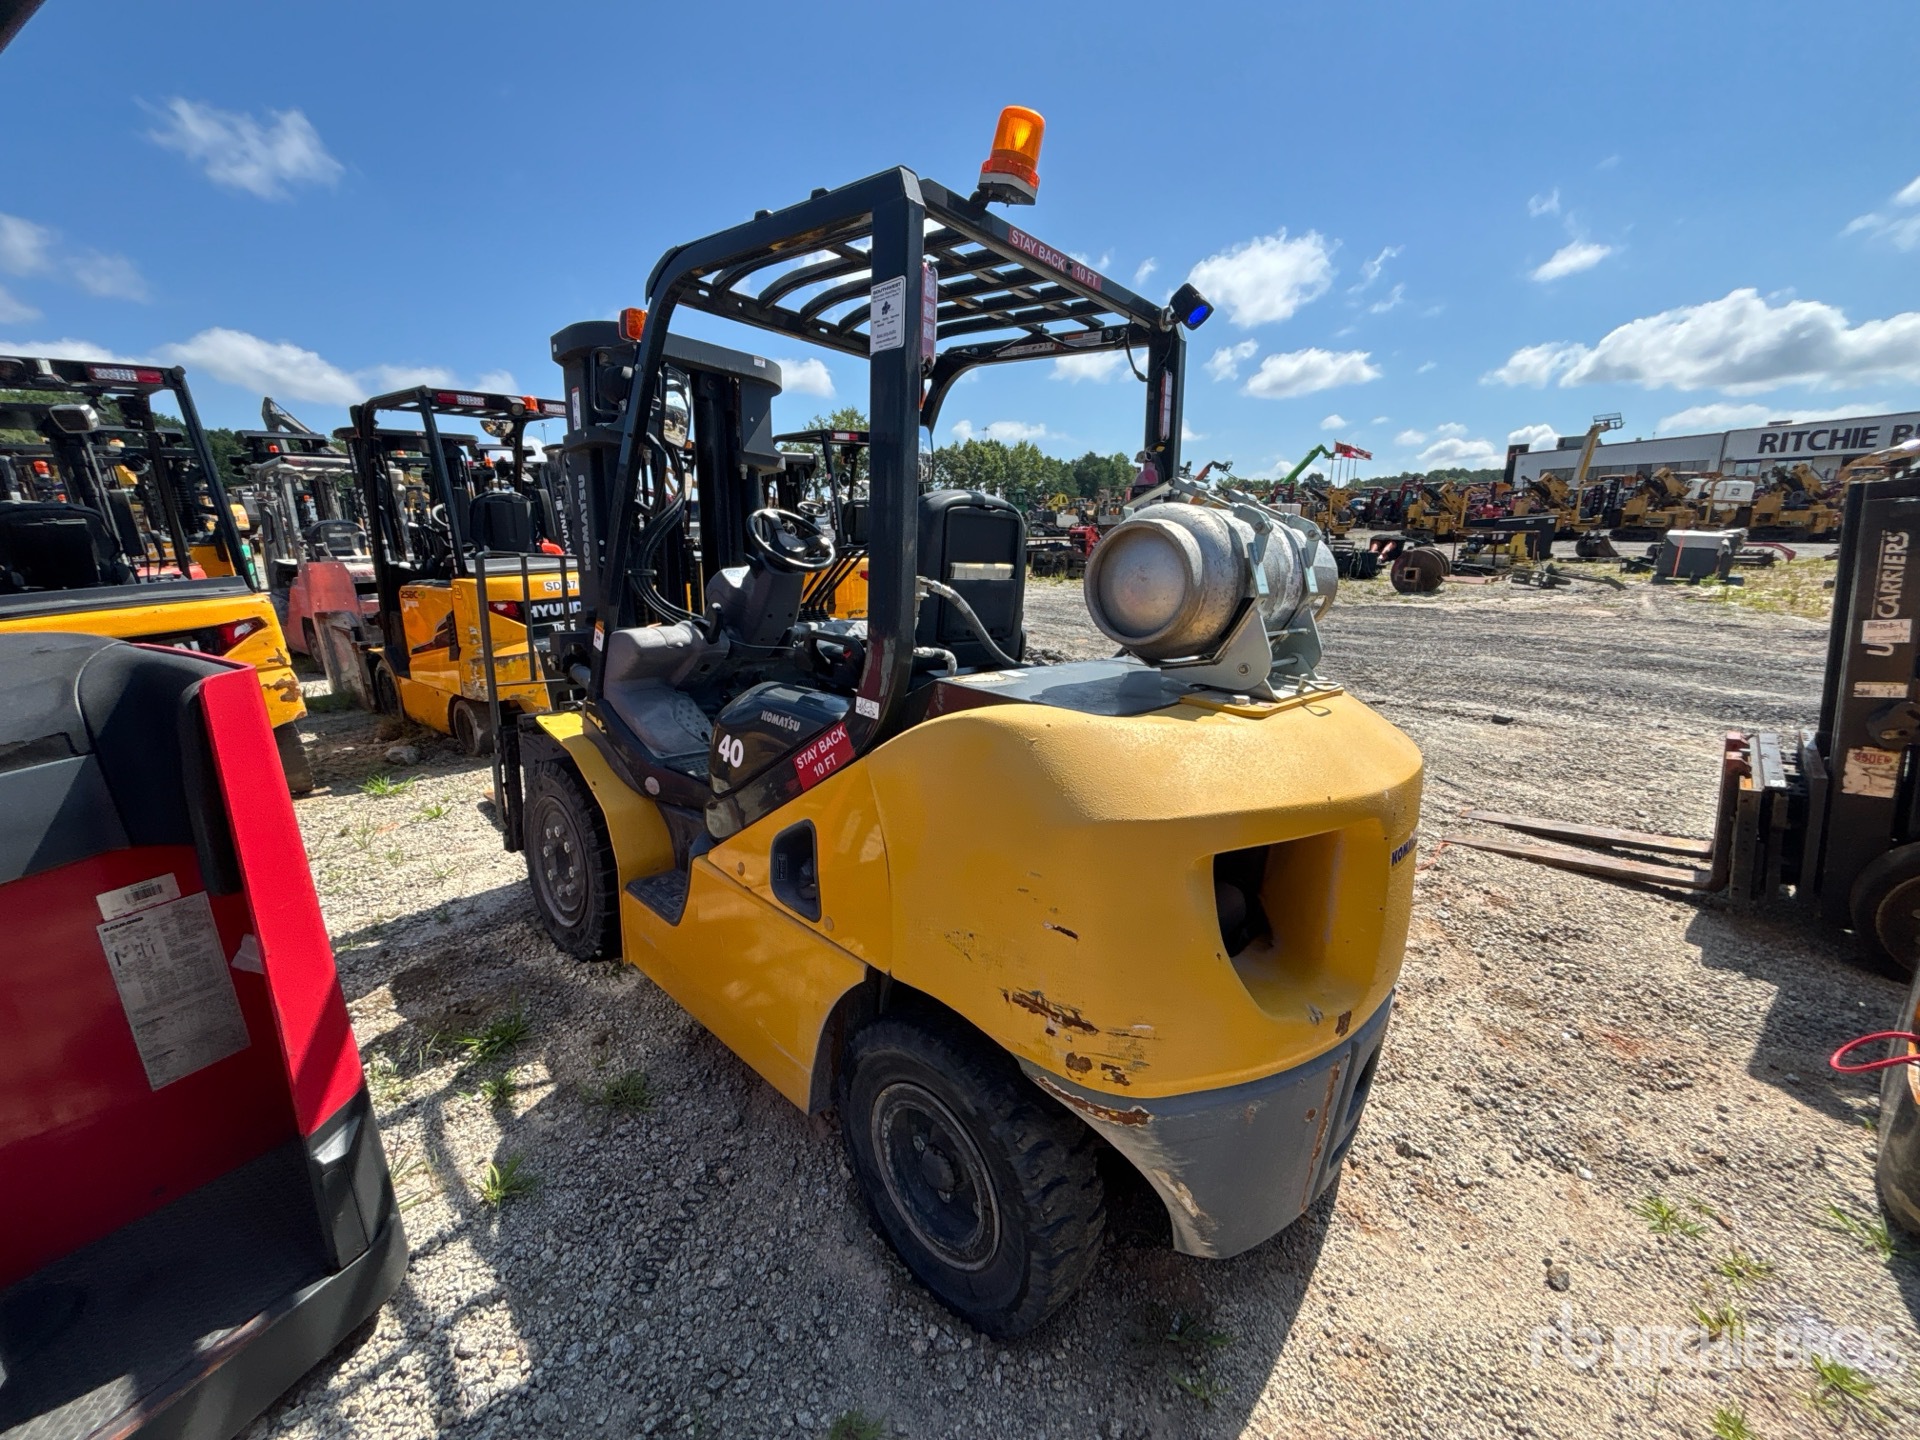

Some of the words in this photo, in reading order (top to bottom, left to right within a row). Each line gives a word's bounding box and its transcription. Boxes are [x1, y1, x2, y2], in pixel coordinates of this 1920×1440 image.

[1011, 229, 1037, 254] STAY
[1038, 245, 1066, 272] BACK
[1076, 265, 1086, 281] 10
[1087, 272, 1098, 287] FT
[1757, 425, 1881, 454] RITCHIE
[577, 474, 592, 572] KOMATSU
[760, 709, 801, 733] KOMATSU
[717, 733, 744, 768] 40
[796, 749, 818, 770] STAY
[818, 726, 847, 752] BACK
[813, 762, 825, 777] 10
[825, 752, 838, 771] FT
